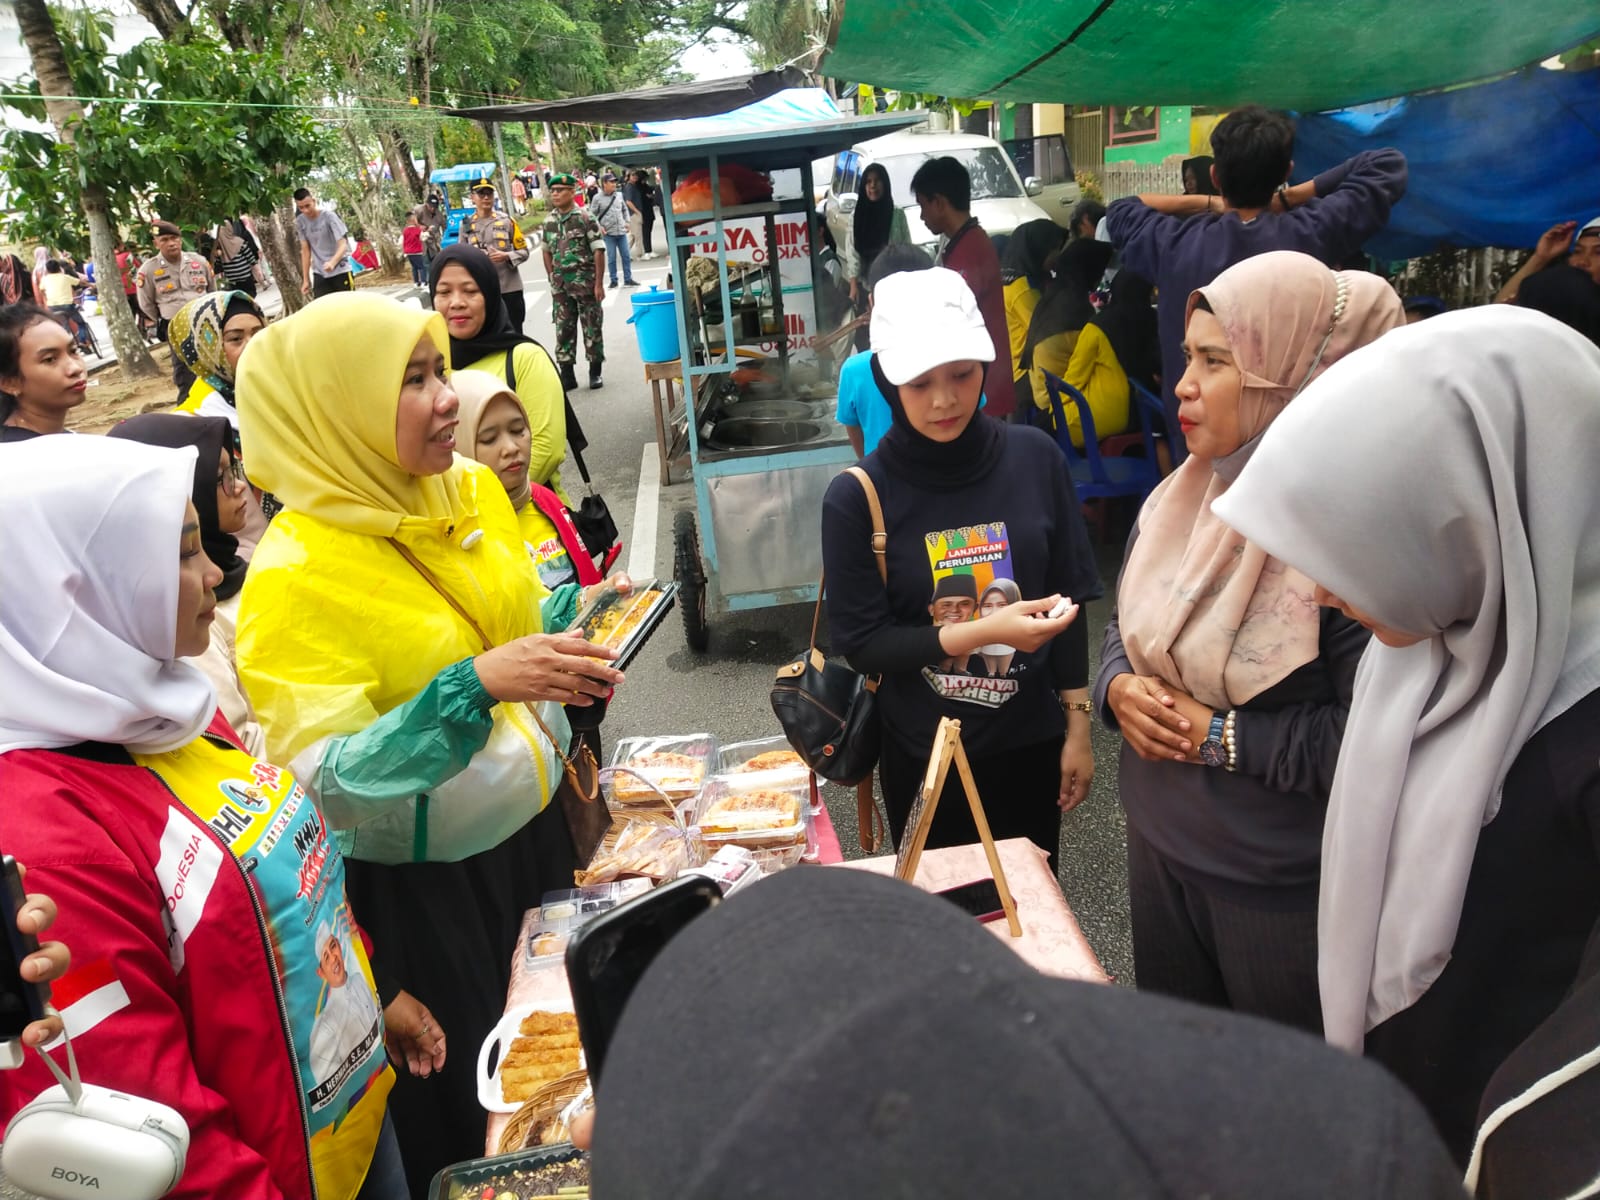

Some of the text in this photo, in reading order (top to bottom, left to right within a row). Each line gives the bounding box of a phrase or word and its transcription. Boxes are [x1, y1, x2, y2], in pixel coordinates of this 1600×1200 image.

[939, 552, 1002, 569] PERUBAHAN
[948, 543, 1002, 558] LANJUTKAN
[167, 834, 203, 912] DONESIA
[51, 1166, 100, 1189] BOYA
